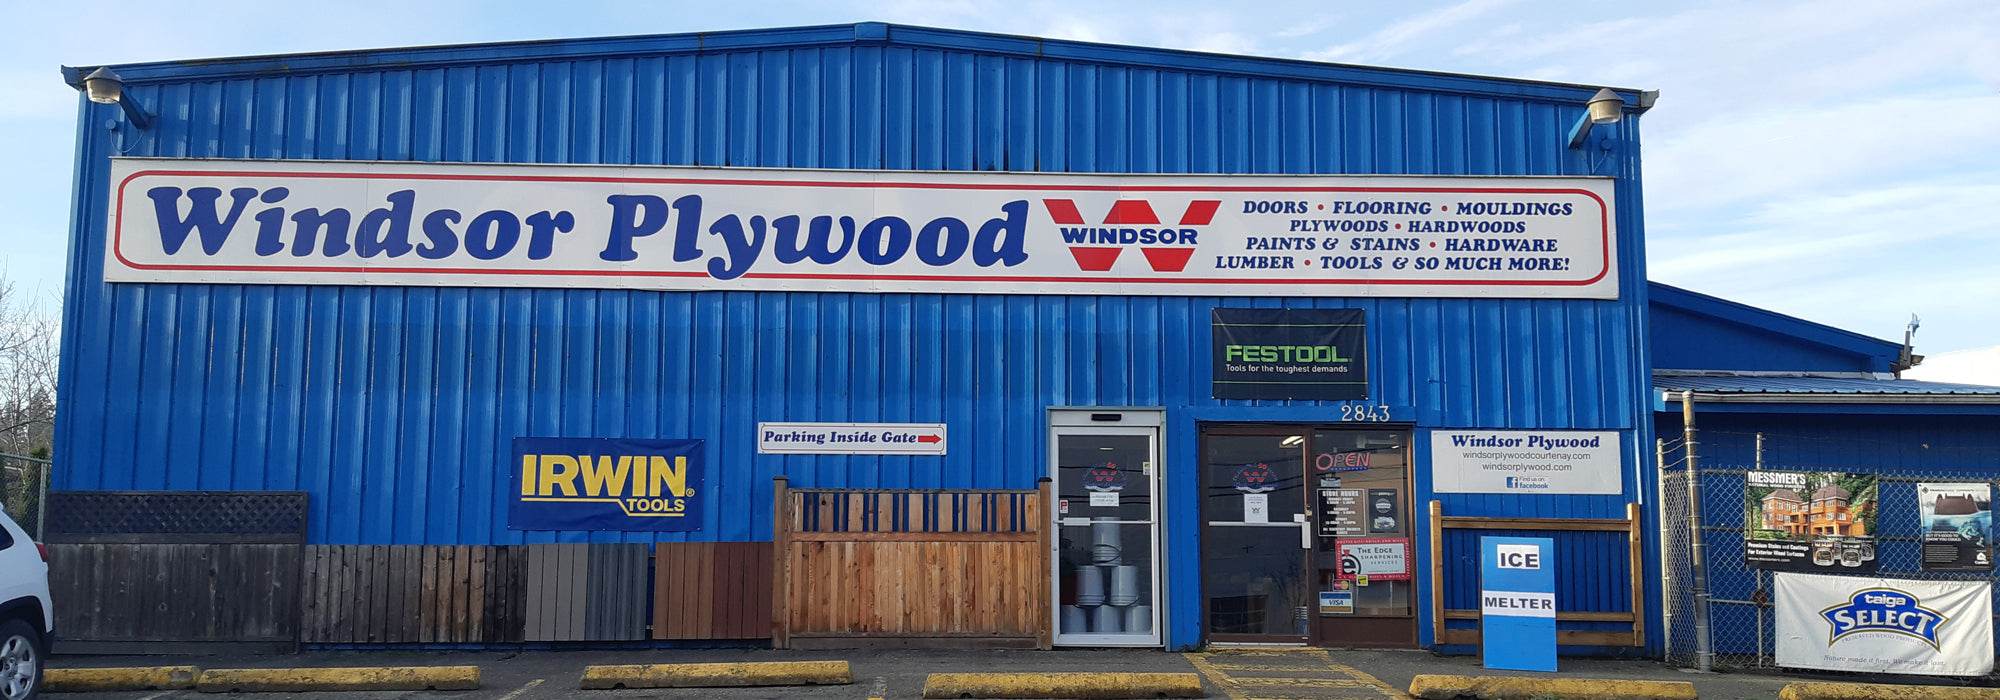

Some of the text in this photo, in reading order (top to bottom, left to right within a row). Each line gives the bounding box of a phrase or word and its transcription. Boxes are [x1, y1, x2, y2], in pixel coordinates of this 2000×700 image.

[1242, 200, 1573, 216] DOORS FLOORING MOULDINGS
[146, 186, 1029, 280] Windsor Plywood
[1289, 219, 1526, 234] PLYWOODS HARDWOODS
[1060, 227, 1199, 246] WINDSOR
[1245, 237, 1558, 252] PAINTS & STAINS HARDWARE
[1215, 255, 1570, 271] LUMBER TOOLS & SO MUCH MORE!
[1226, 345, 1350, 363] FESTOOL
[1226, 364, 1348, 374] Tools for the toughest demands
[1341, 405, 1390, 422] 2843
[764, 430, 917, 445] Parking Inside Gate
[1451, 435, 1600, 450] Windsor Plywood
[1316, 452, 1370, 471] OPEN
[1462, 451, 1591, 461] windsorplywoodcourtenay.com
[520, 454, 687, 497] IRWIN
[1482, 463, 1572, 473] windsorplywood.com
[1748, 471, 1806, 485] MESSMER'S
[627, 498, 685, 512] TOOLS
[1500, 553, 1538, 568] ICE
[1485, 597, 1552, 609] MELTER
[1864, 594, 1906, 608] taiga
[1834, 610, 1935, 634] SELECT
[1824, 654, 1846, 662] Nature
